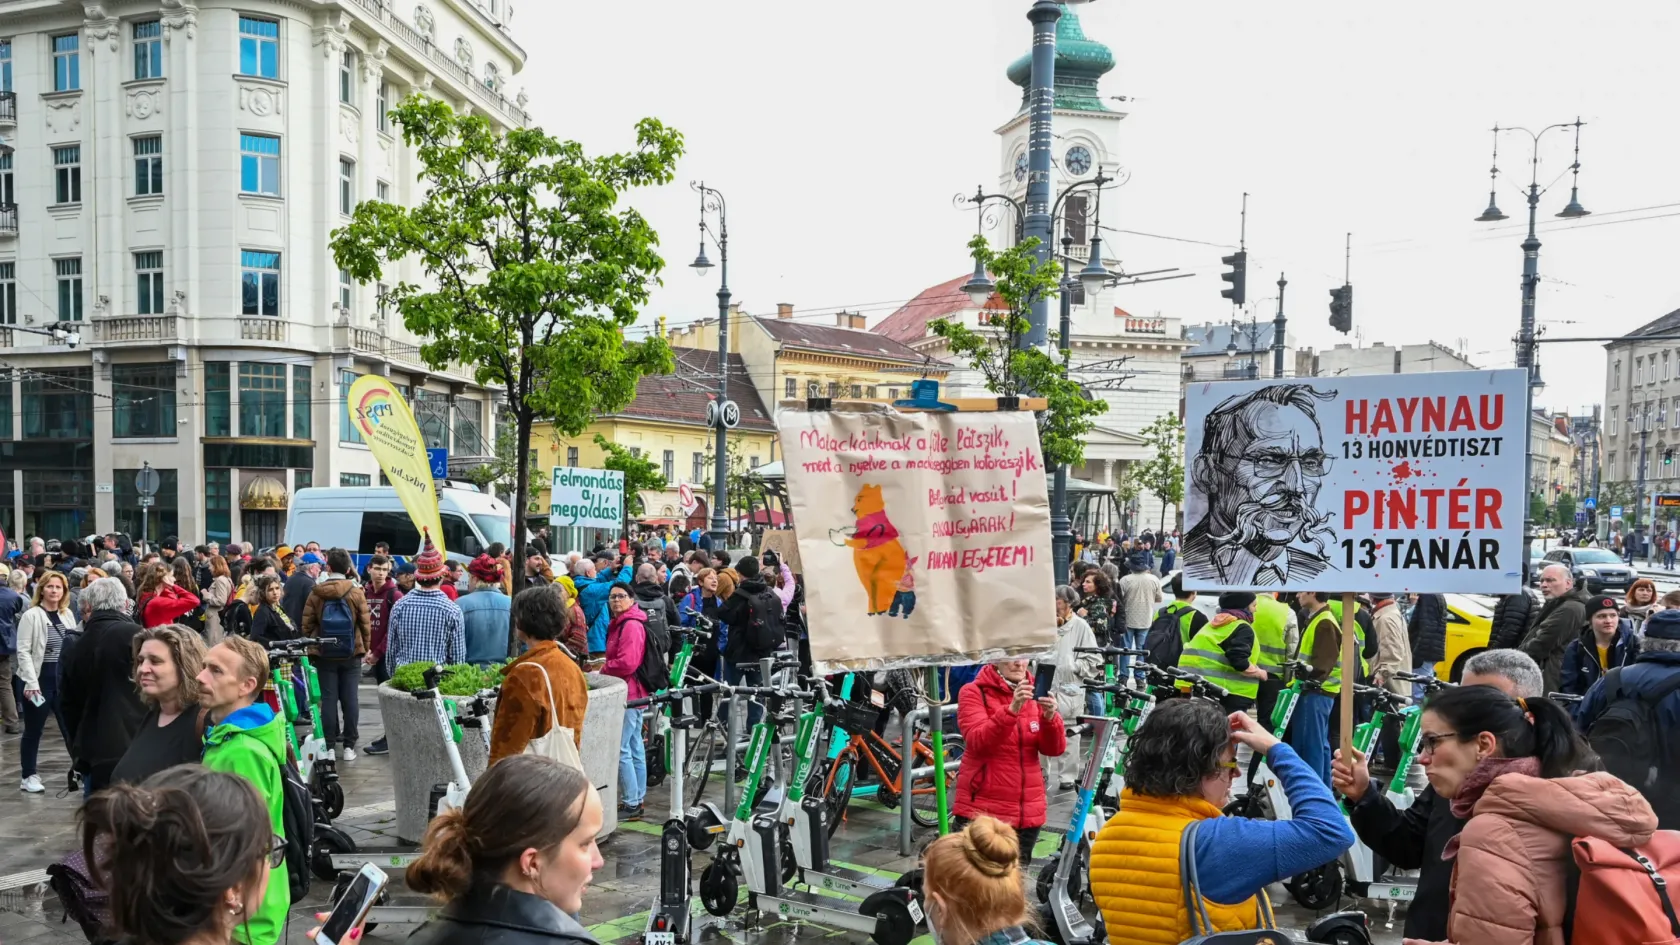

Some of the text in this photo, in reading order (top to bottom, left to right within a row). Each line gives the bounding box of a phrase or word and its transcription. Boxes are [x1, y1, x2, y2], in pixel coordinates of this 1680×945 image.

[1345, 394, 1504, 435] HAYNAU
[800, 429, 911, 451] Malackánknak
[917, 438, 926, 451] a
[1342, 434, 1504, 459] 13 HONVÉDTISZT
[833, 463, 844, 473] a
[849, 455, 887, 476] nyelve
[891, 460, 901, 470] a
[553, 467, 623, 491] Felmondás
[581, 489, 591, 500] a
[1343, 477, 1503, 530] PINTÉR
[551, 493, 623, 526] megoldás!
[1341, 530, 1500, 570] 13 TANÁR
[792, 762, 809, 789] Lime
[1069, 795, 1084, 832] BIRD
[834, 881, 851, 891] Lime
[1402, 889, 1416, 897] Lim
[792, 905, 811, 917] Lime
